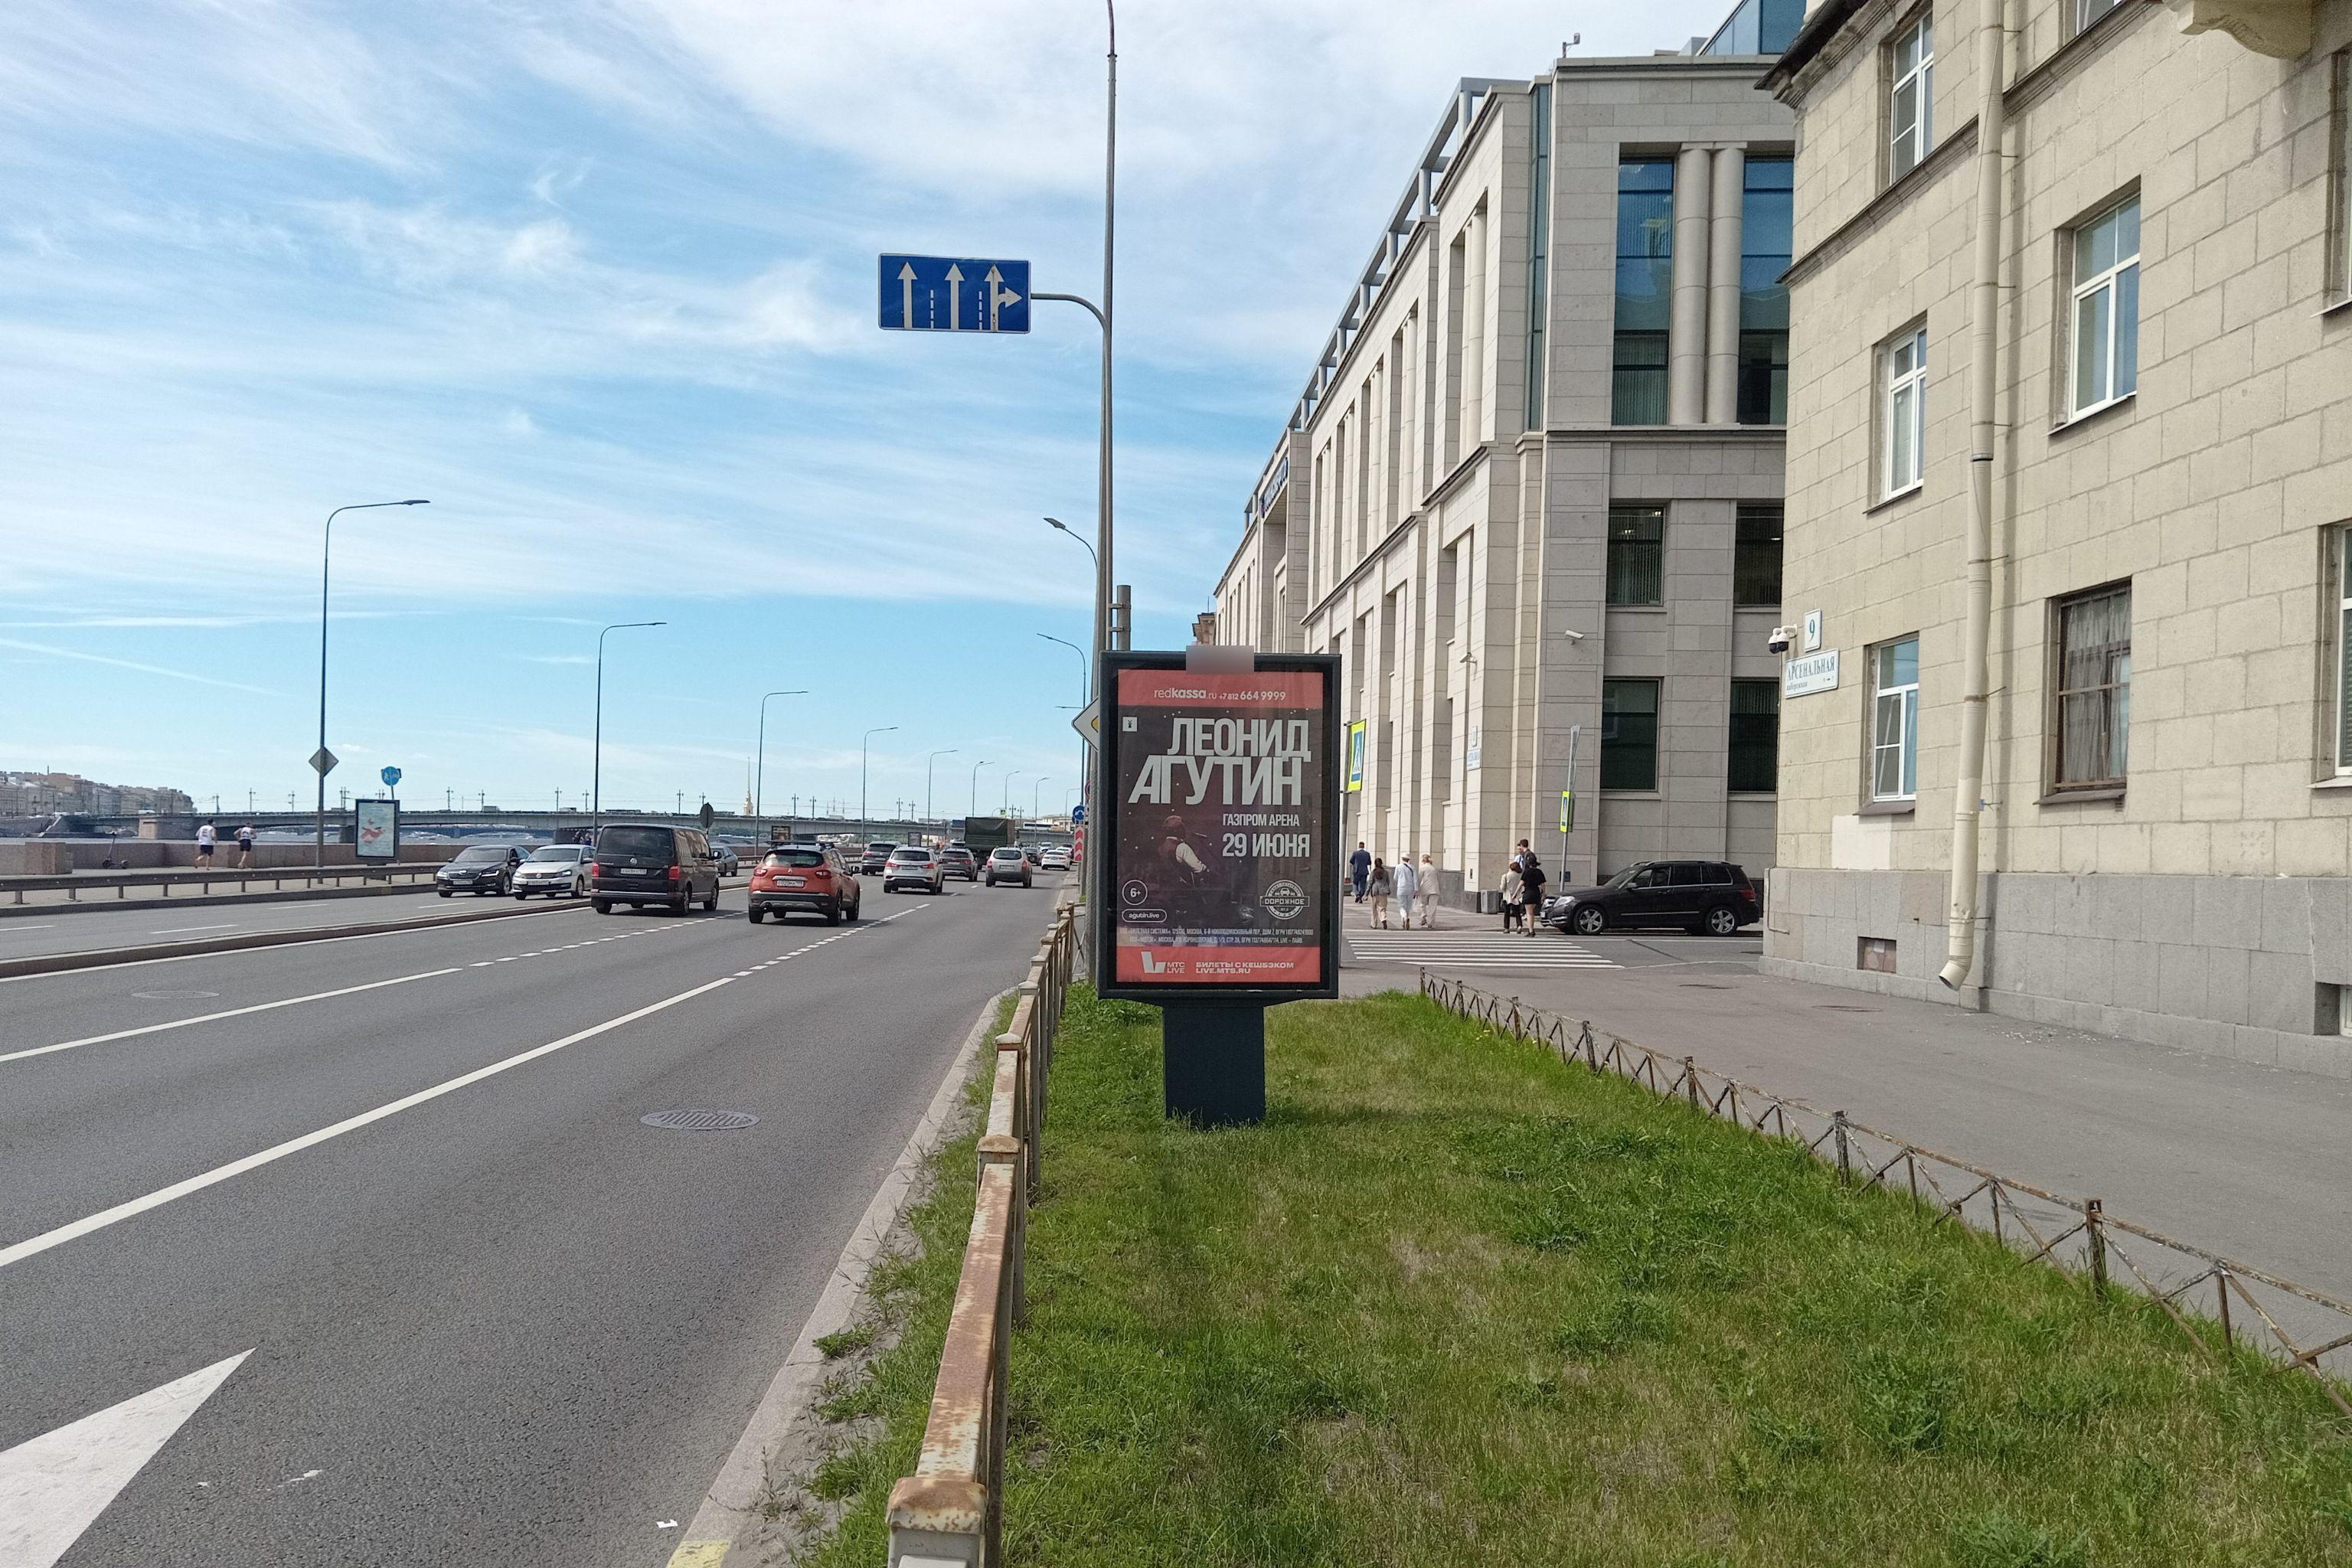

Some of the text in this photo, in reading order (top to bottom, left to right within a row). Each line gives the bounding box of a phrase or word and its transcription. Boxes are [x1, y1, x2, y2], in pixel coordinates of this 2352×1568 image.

[1809, 619, 1815, 642] 9
[1788, 656, 1834, 681] АРСЕНАЛЬНАЯ
[1154, 688, 1217, 699] redkassa.ru
[1240, 691, 1259, 700] 664
[1261, 691, 1286, 701] 9999
[1167, 717, 1312, 763] ЛЕОНИД
[1128, 754, 1302, 805] АГУТИН
[1223, 813, 1300, 826] ГАЗПРОМ АРЕНА
[1222, 832, 1310, 858] 29 ИЮНЯ
[1130, 887, 1141, 897] 6+
